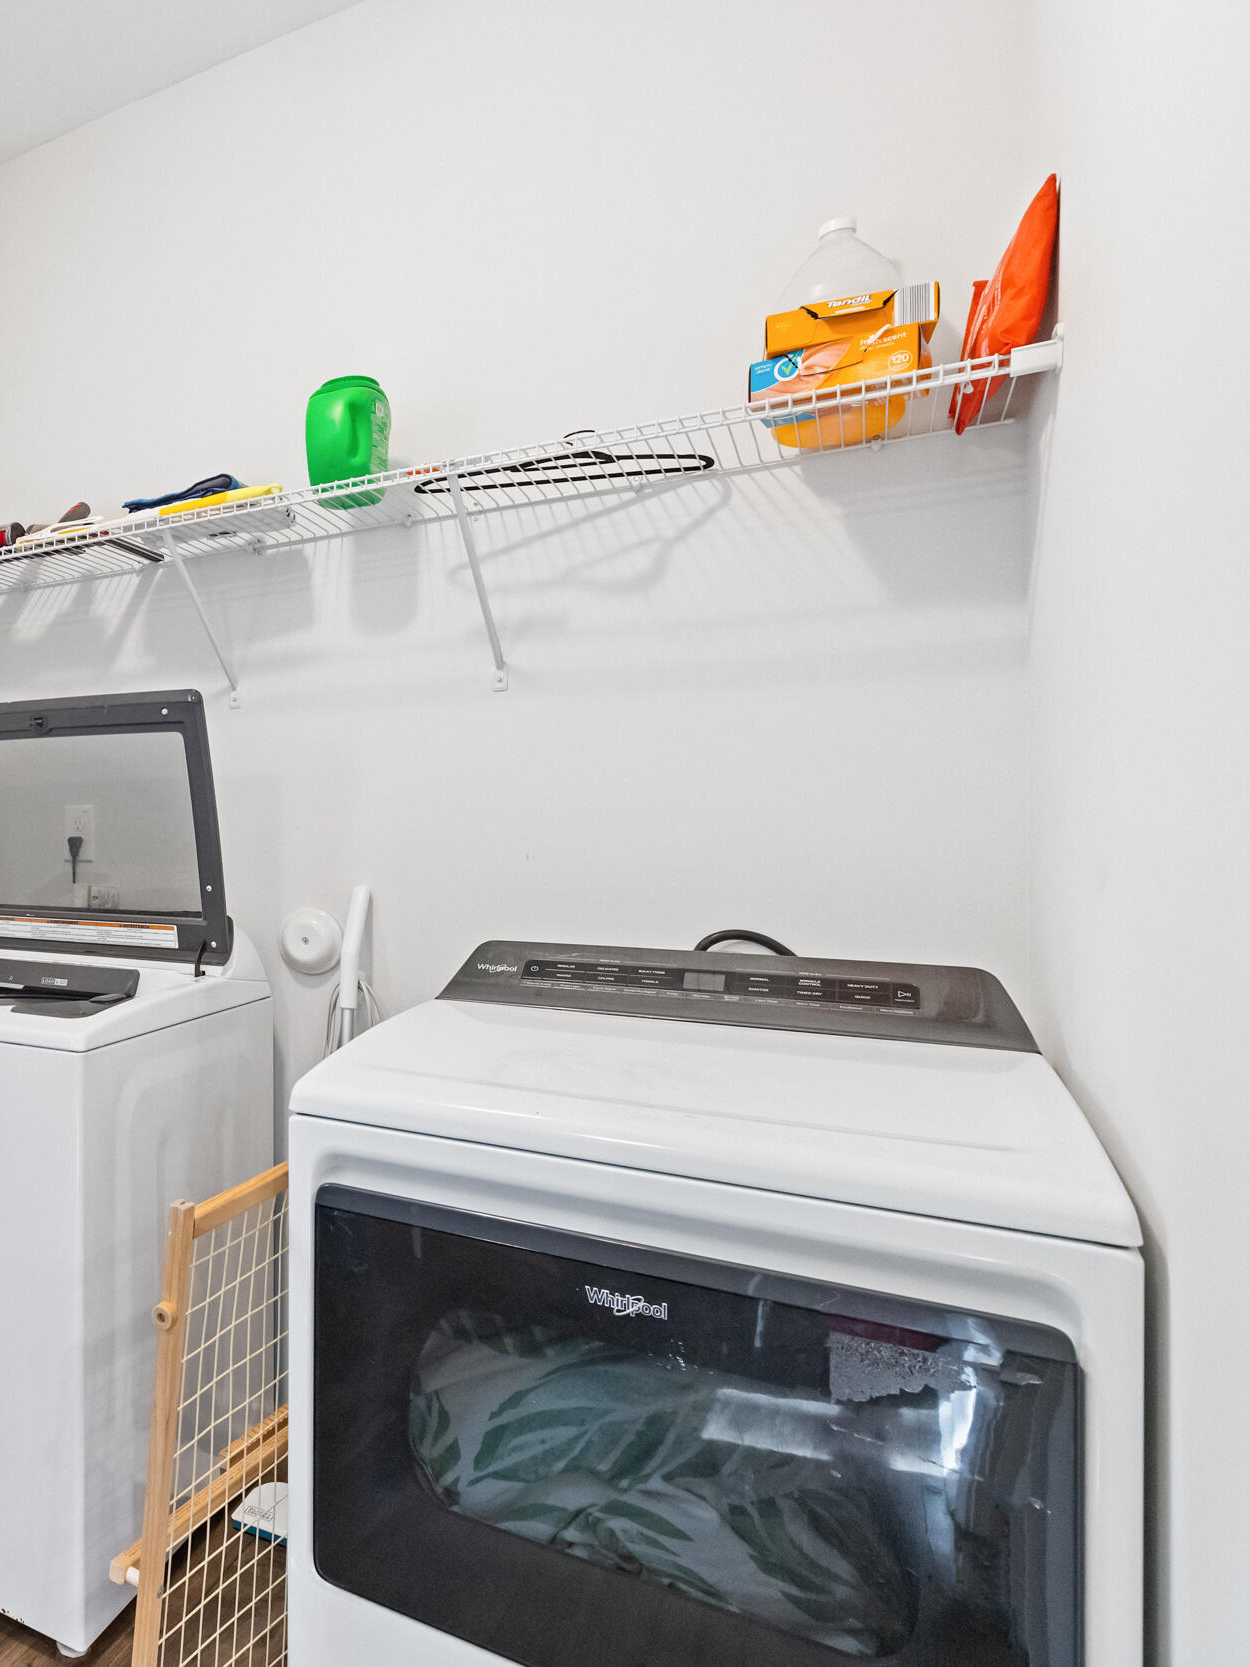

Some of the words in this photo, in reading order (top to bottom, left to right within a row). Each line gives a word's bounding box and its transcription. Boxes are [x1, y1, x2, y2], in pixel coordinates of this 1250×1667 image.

[827, 295, 871, 308] Tandil
[883, 332, 907, 343] scent
[892, 353, 909, 364] 120
[477, 963, 518, 973] Whirlpool
[585, 1285, 668, 1320] Whirlpool
